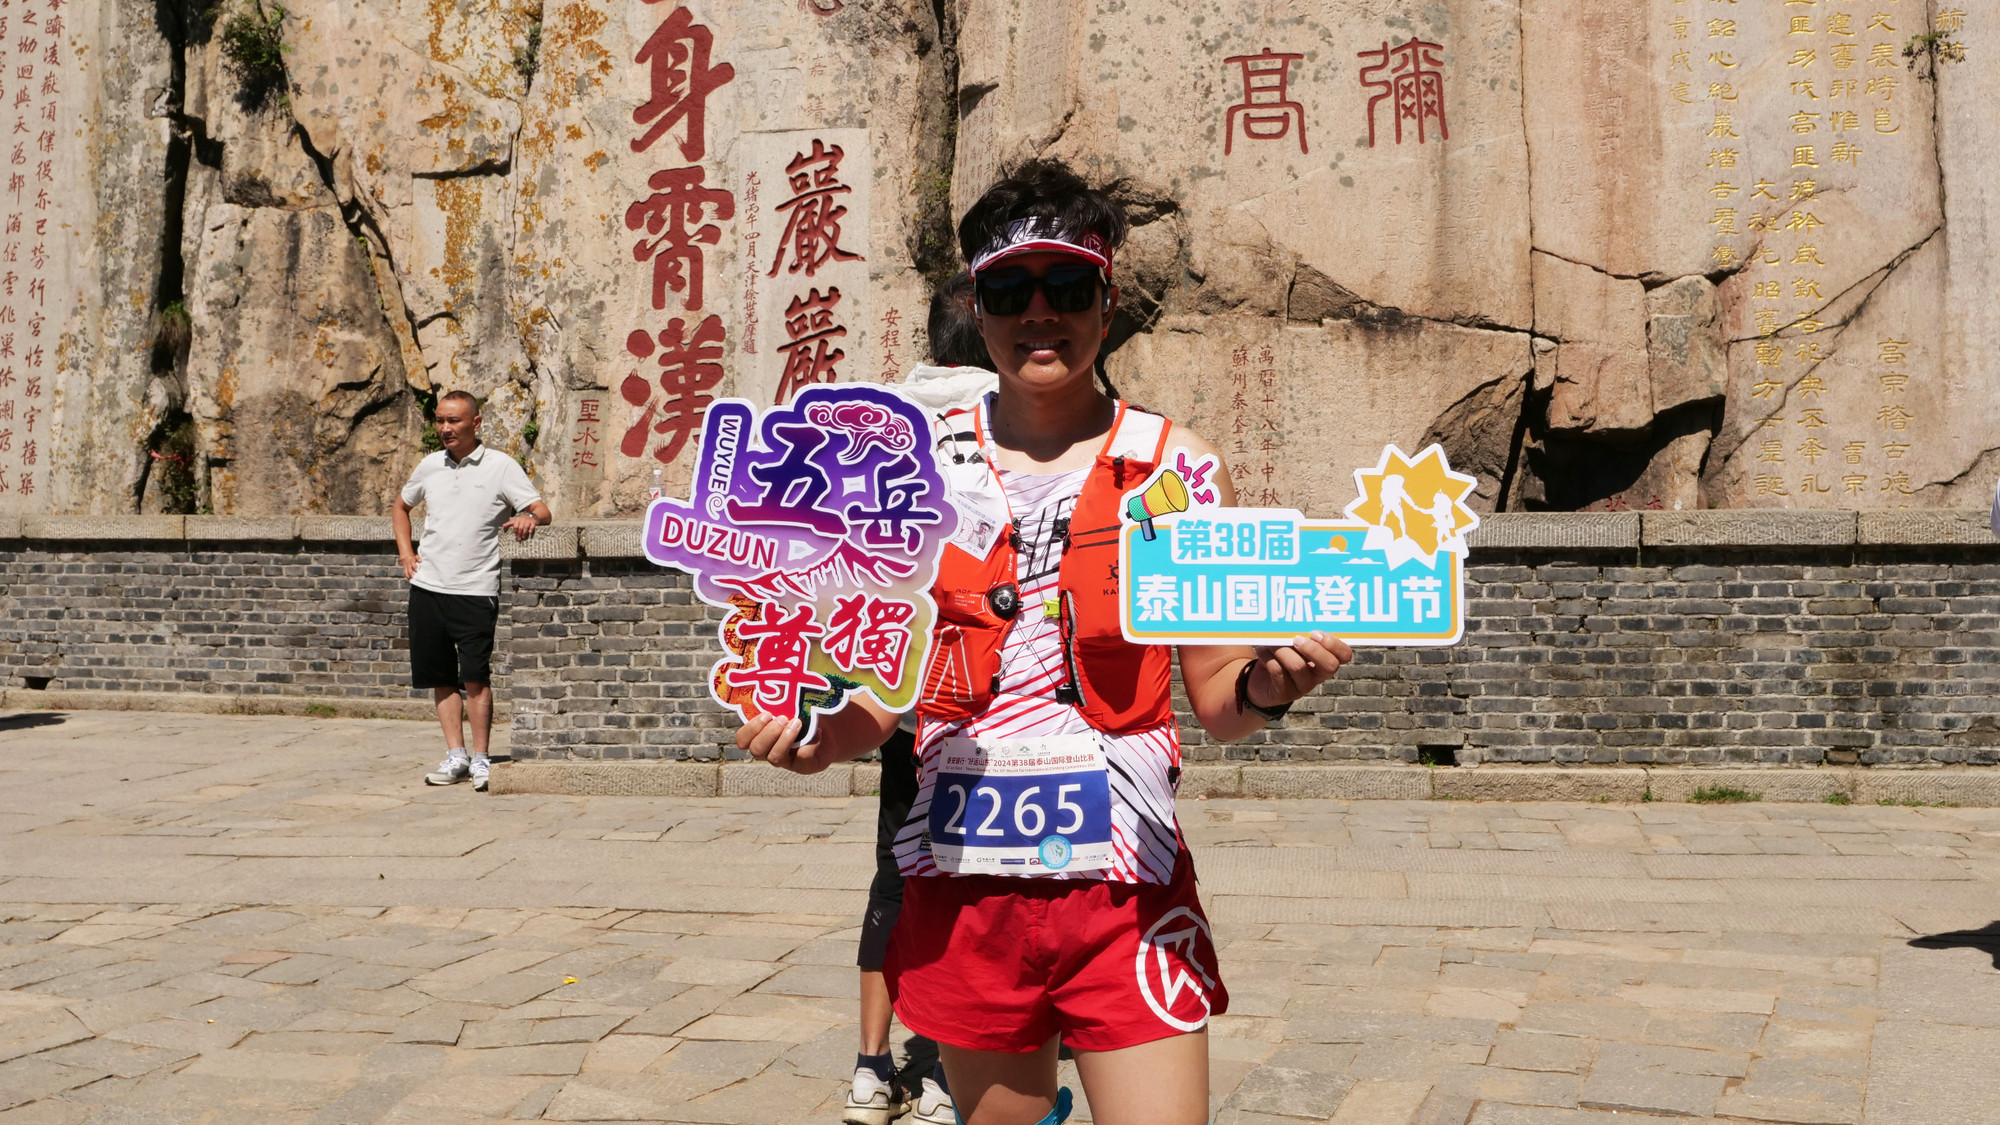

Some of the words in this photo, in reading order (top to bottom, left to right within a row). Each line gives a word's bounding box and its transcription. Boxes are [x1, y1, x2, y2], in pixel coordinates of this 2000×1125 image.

[1668, 0, 1693, 104] 景戌建
[620, 0, 735, 463] 身霄漢
[572, 399, 600, 469] 聖水池
[711, 418, 740, 492] WUYUE
[1877, 337, 1914, 509] 高宗稽古德
[662, 516, 776, 570] DUZUN
[1175, 519, 1296, 561] 第38届
[1135, 573, 1443, 624] 泰山国际登山节
[944, 781, 1084, 837] 2265
